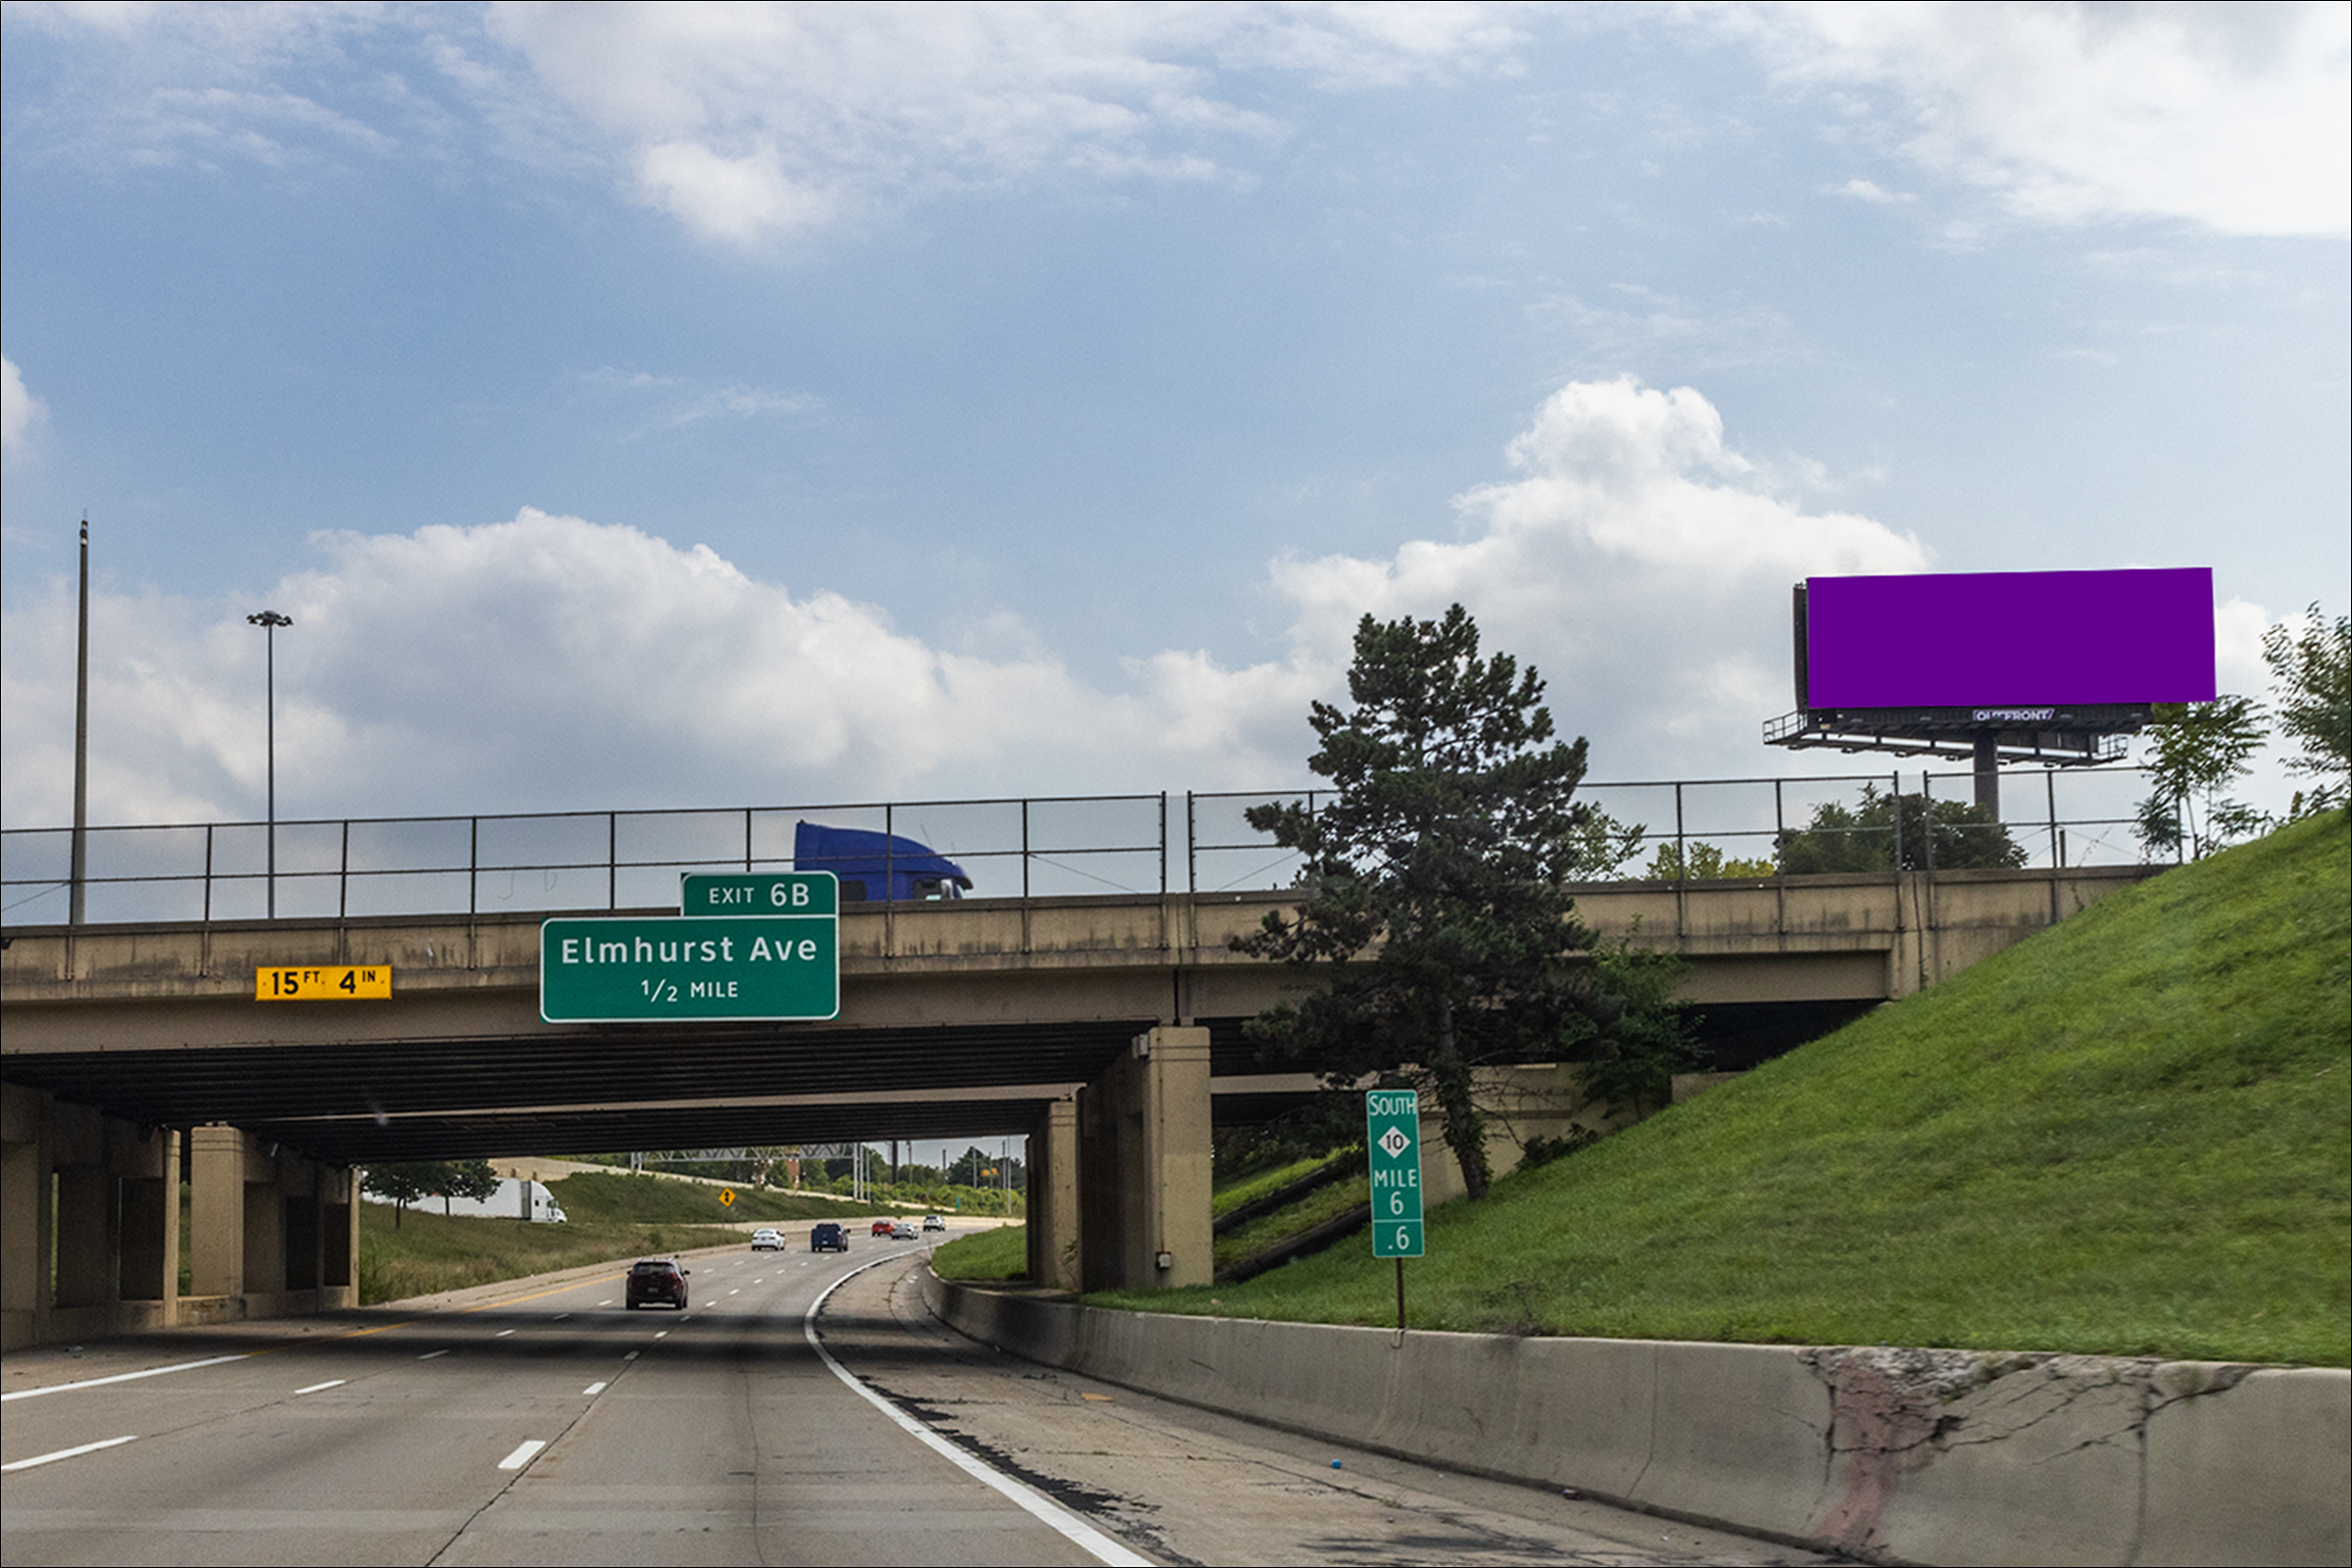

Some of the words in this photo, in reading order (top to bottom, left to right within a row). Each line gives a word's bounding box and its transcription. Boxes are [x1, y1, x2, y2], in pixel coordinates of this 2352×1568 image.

[709, 887, 755, 905] EXIT
[769, 882, 810, 906] 6B
[562, 937, 734, 964] Elmhurst
[749, 937, 817, 962] Ave
[271, 971, 299, 996] 15
[339, 970, 356, 995] 4
[362, 970, 376, 983] IN
[640, 978, 678, 1003] 1/2
[690, 981, 739, 999] MILE
[1369, 1095, 1416, 1116] SOUTH
[1386, 1134, 1404, 1151] 10
[1374, 1169, 1418, 1188] MILE
[1390, 1191, 1404, 1215] 6
[1388, 1225, 1410, 1250] .6
